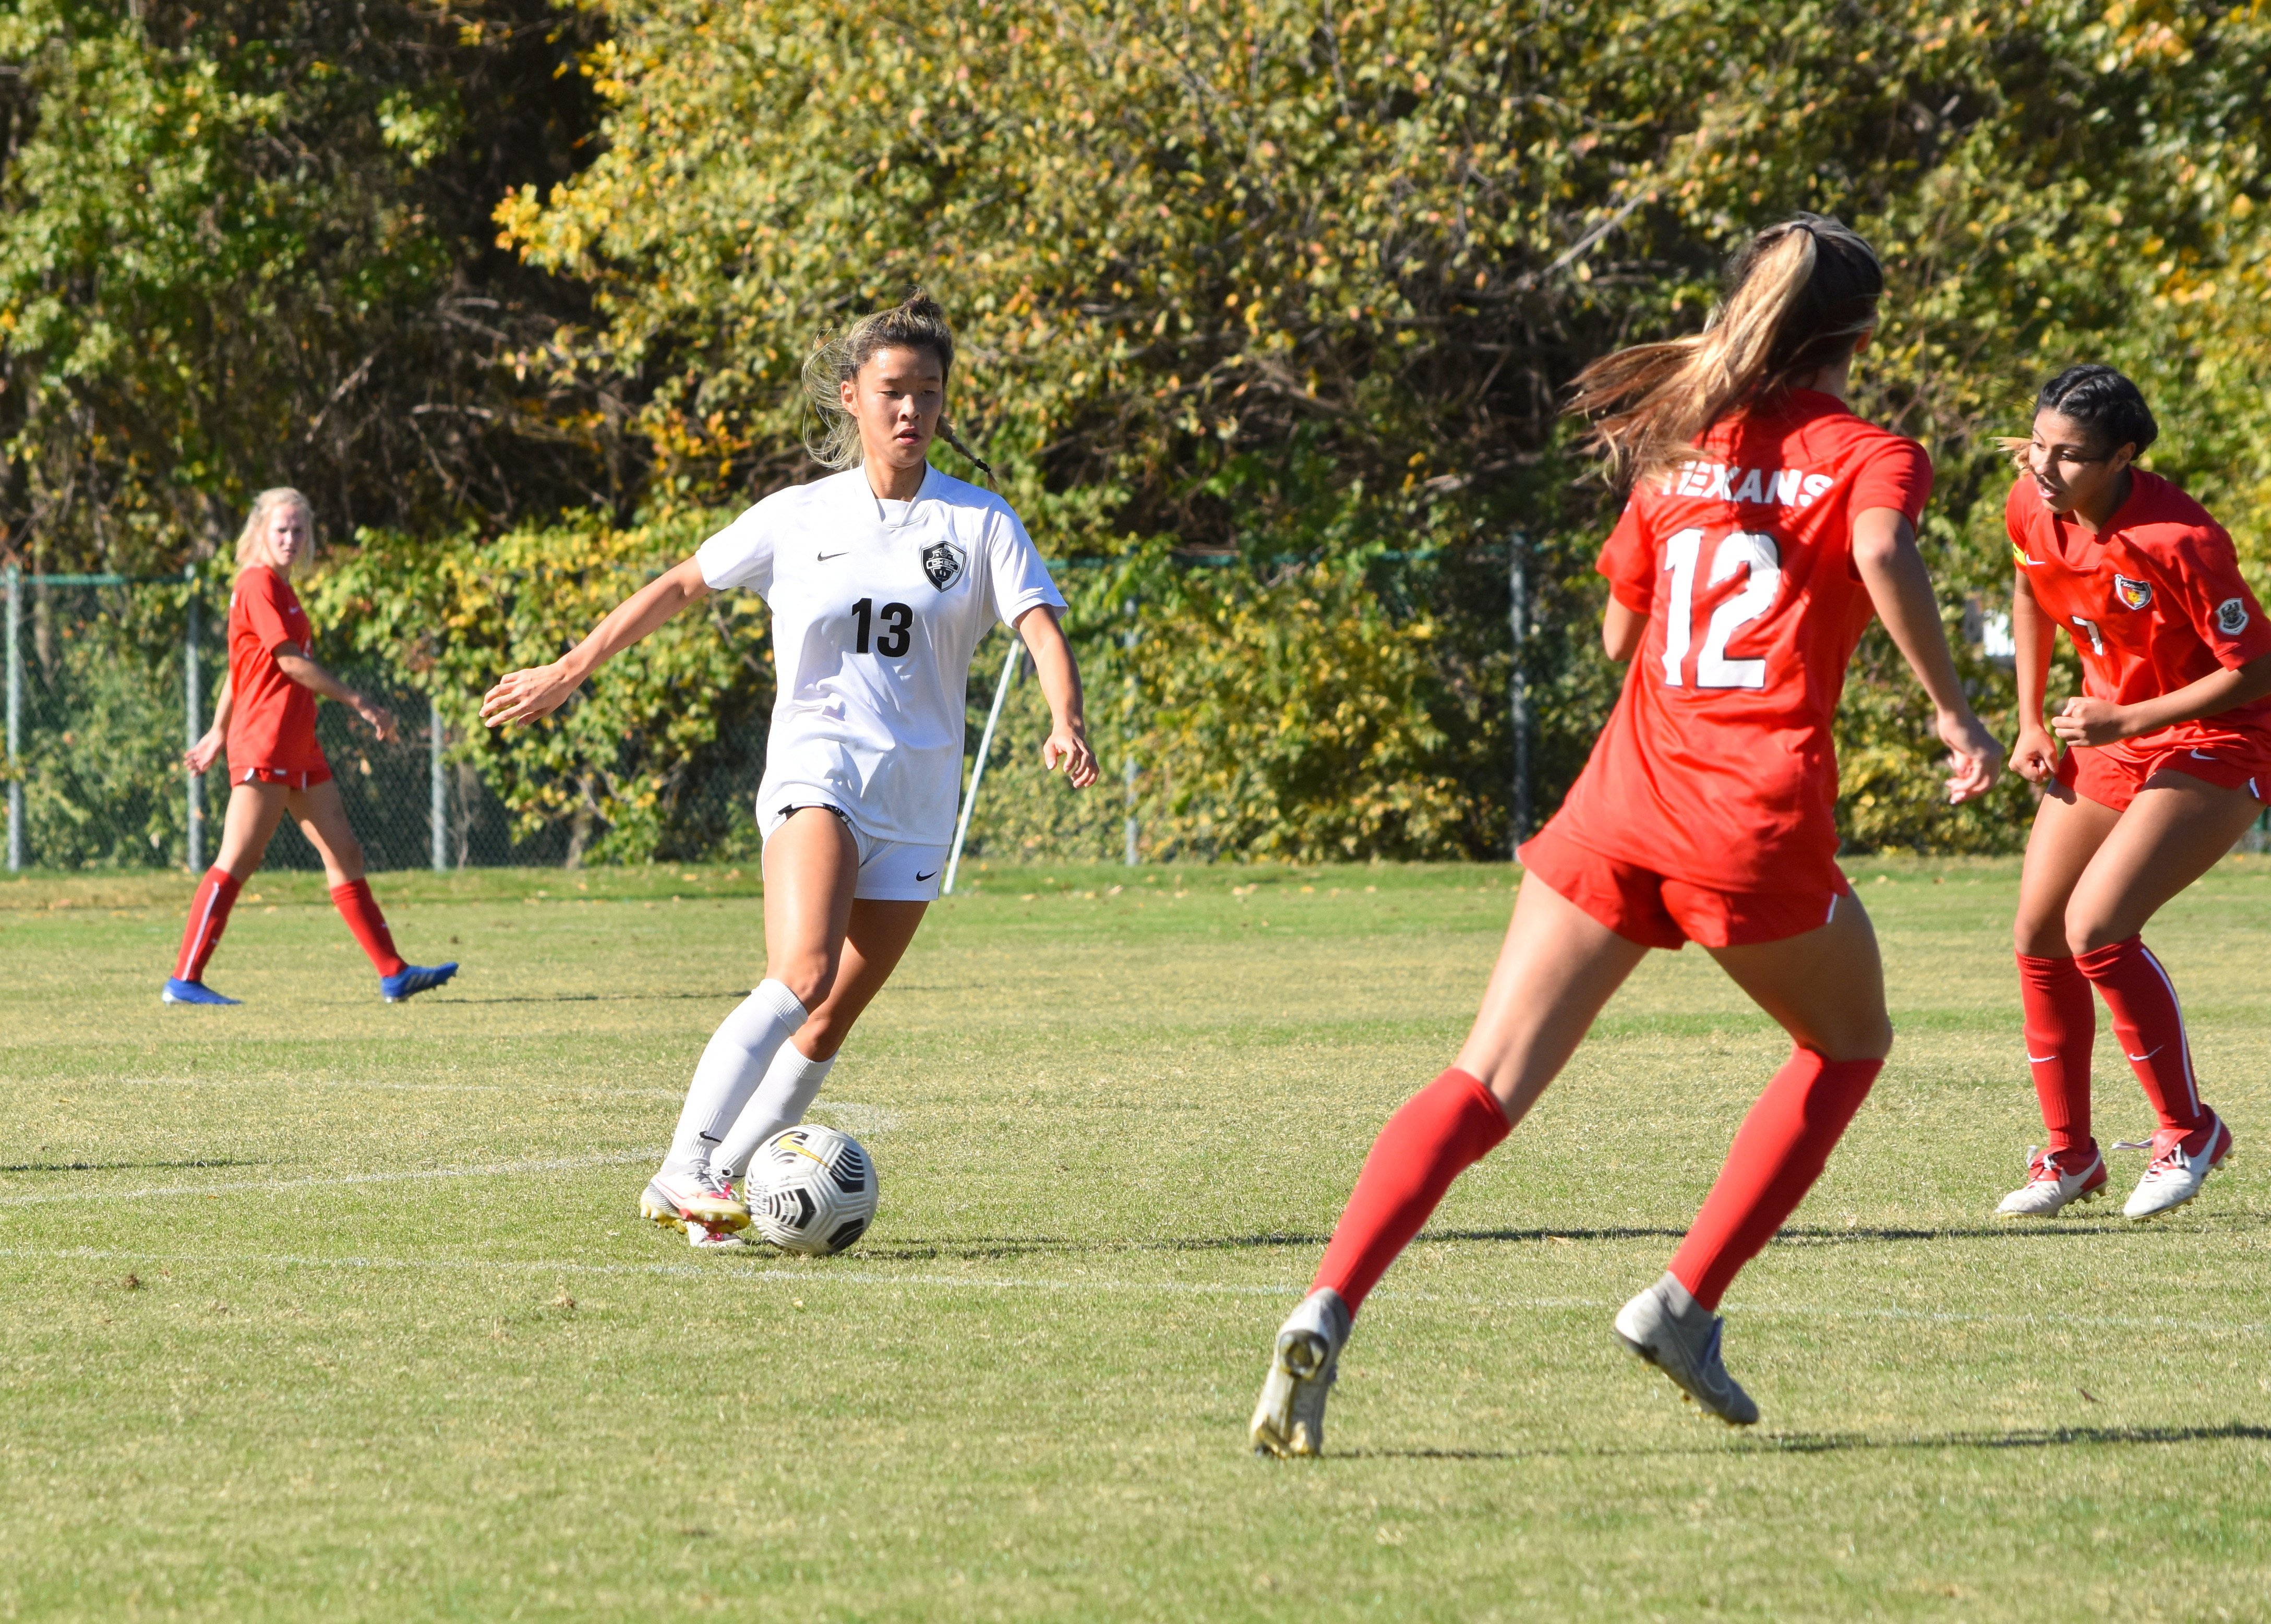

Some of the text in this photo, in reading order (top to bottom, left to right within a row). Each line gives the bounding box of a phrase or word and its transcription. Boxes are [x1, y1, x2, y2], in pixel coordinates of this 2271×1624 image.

[851, 598, 914, 657] 13
[1661, 527, 1782, 690] 12
[2070, 616, 2104, 656] 7
